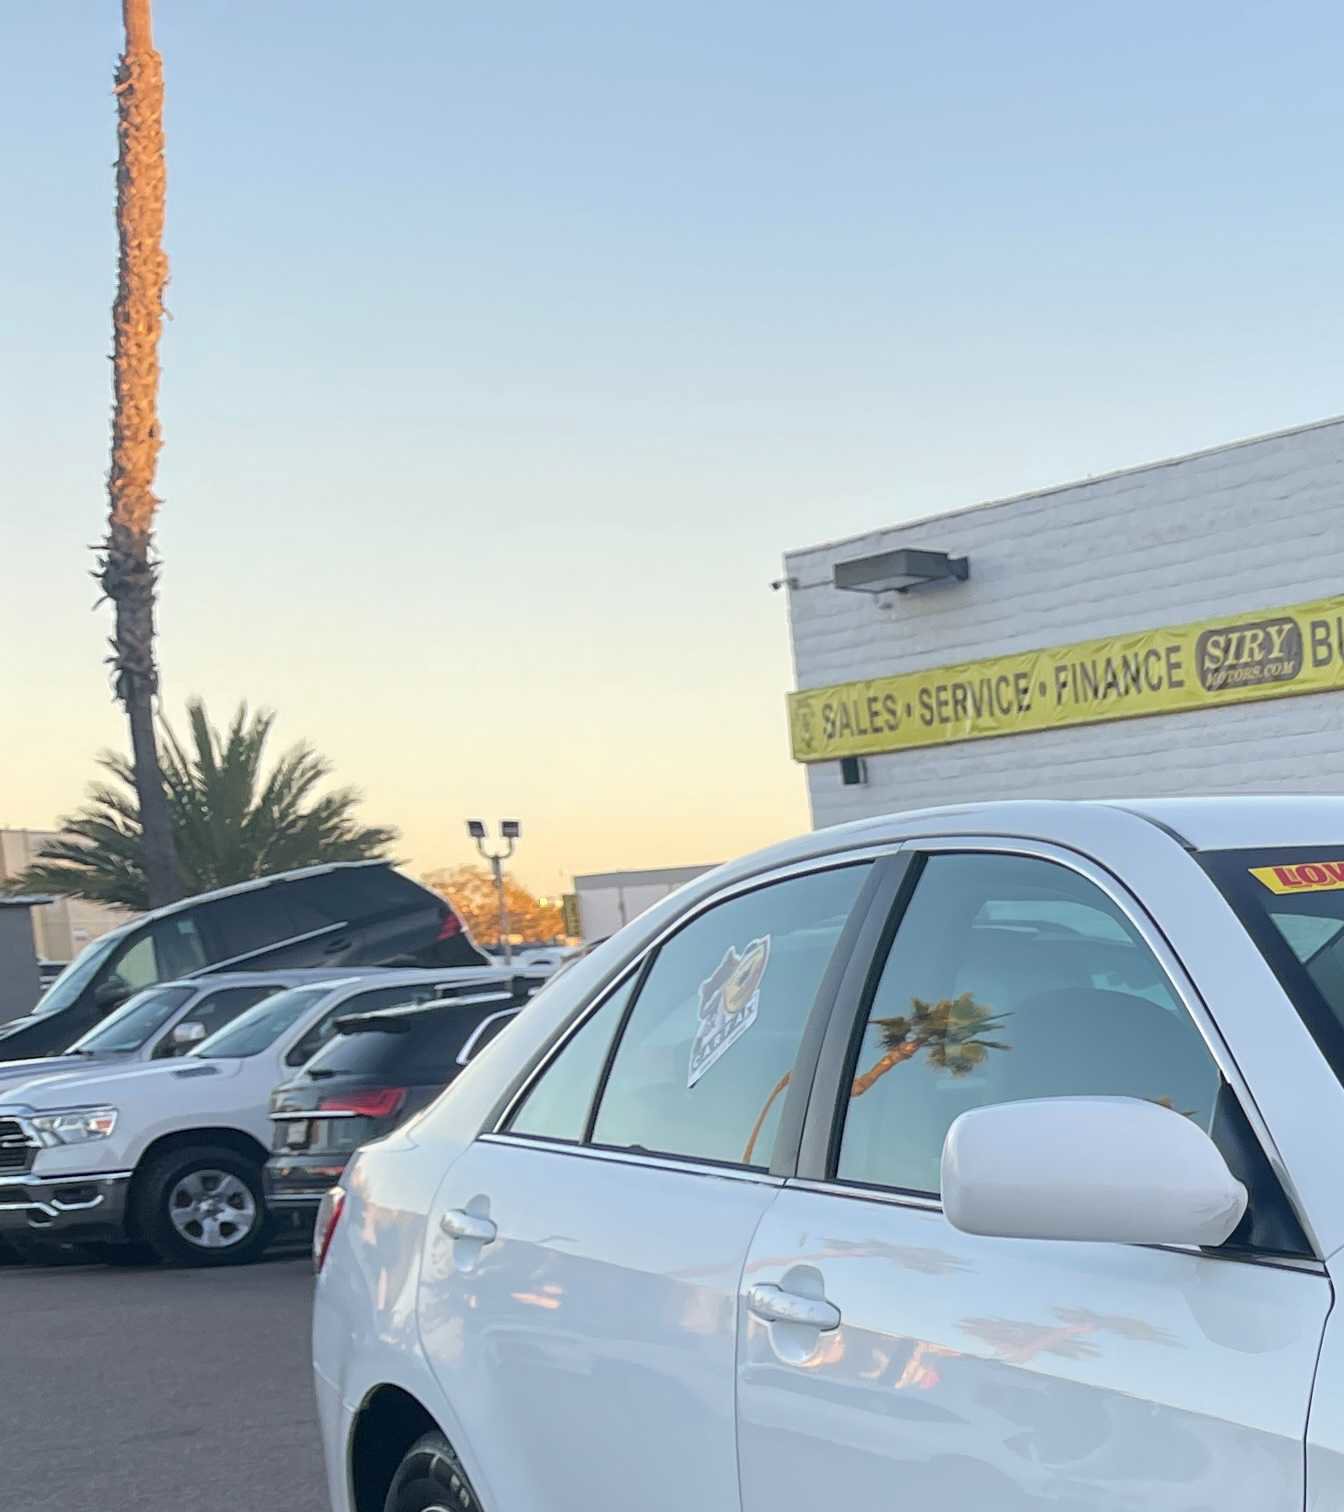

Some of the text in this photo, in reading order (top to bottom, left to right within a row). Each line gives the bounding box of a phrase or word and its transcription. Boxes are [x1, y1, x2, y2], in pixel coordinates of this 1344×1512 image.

[1203, 622, 1295, 671] SIRY
[822, 645, 1185, 740] SALES SERVICE FINANCE
[1205, 660, 1295, 688] MOTORS.COM
